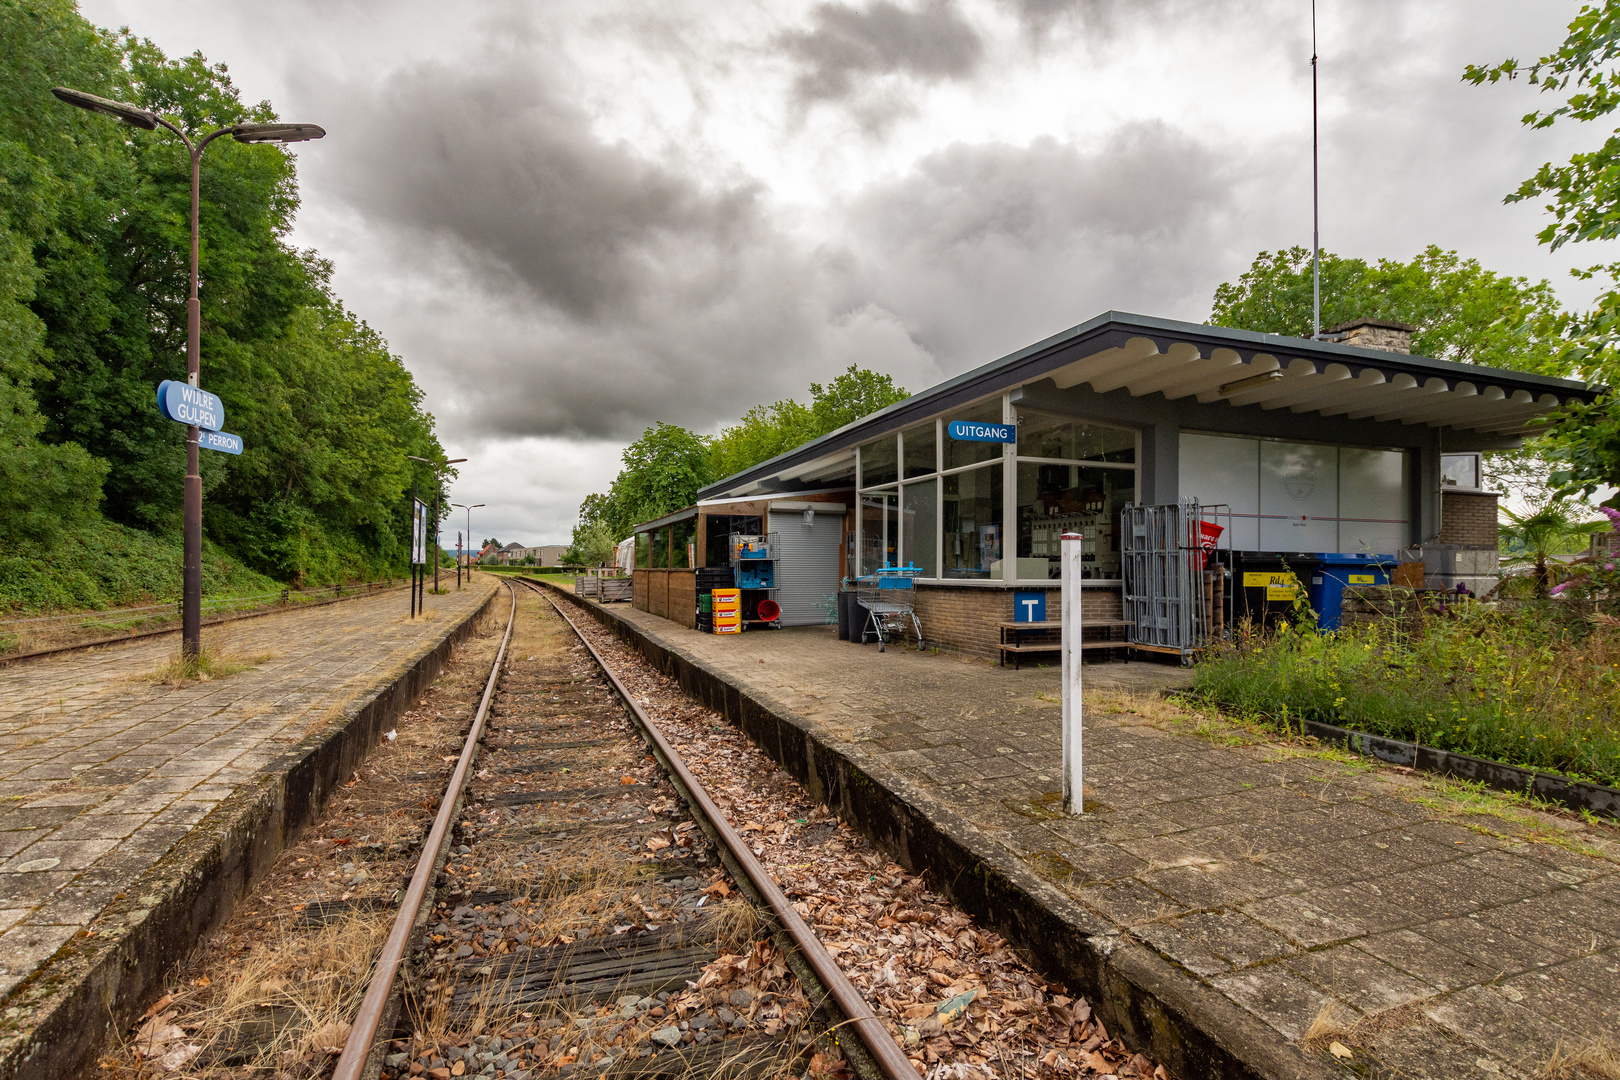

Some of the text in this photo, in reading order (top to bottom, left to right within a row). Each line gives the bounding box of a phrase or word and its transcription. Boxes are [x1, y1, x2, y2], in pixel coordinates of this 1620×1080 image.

[181, 386, 214, 411] WIJLRE
[177, 403, 216, 428] GULPEN
[208, 433, 239, 450] PERRON
[956, 425, 1008, 439] UITGANG
[1022, 599, 1039, 622] T
